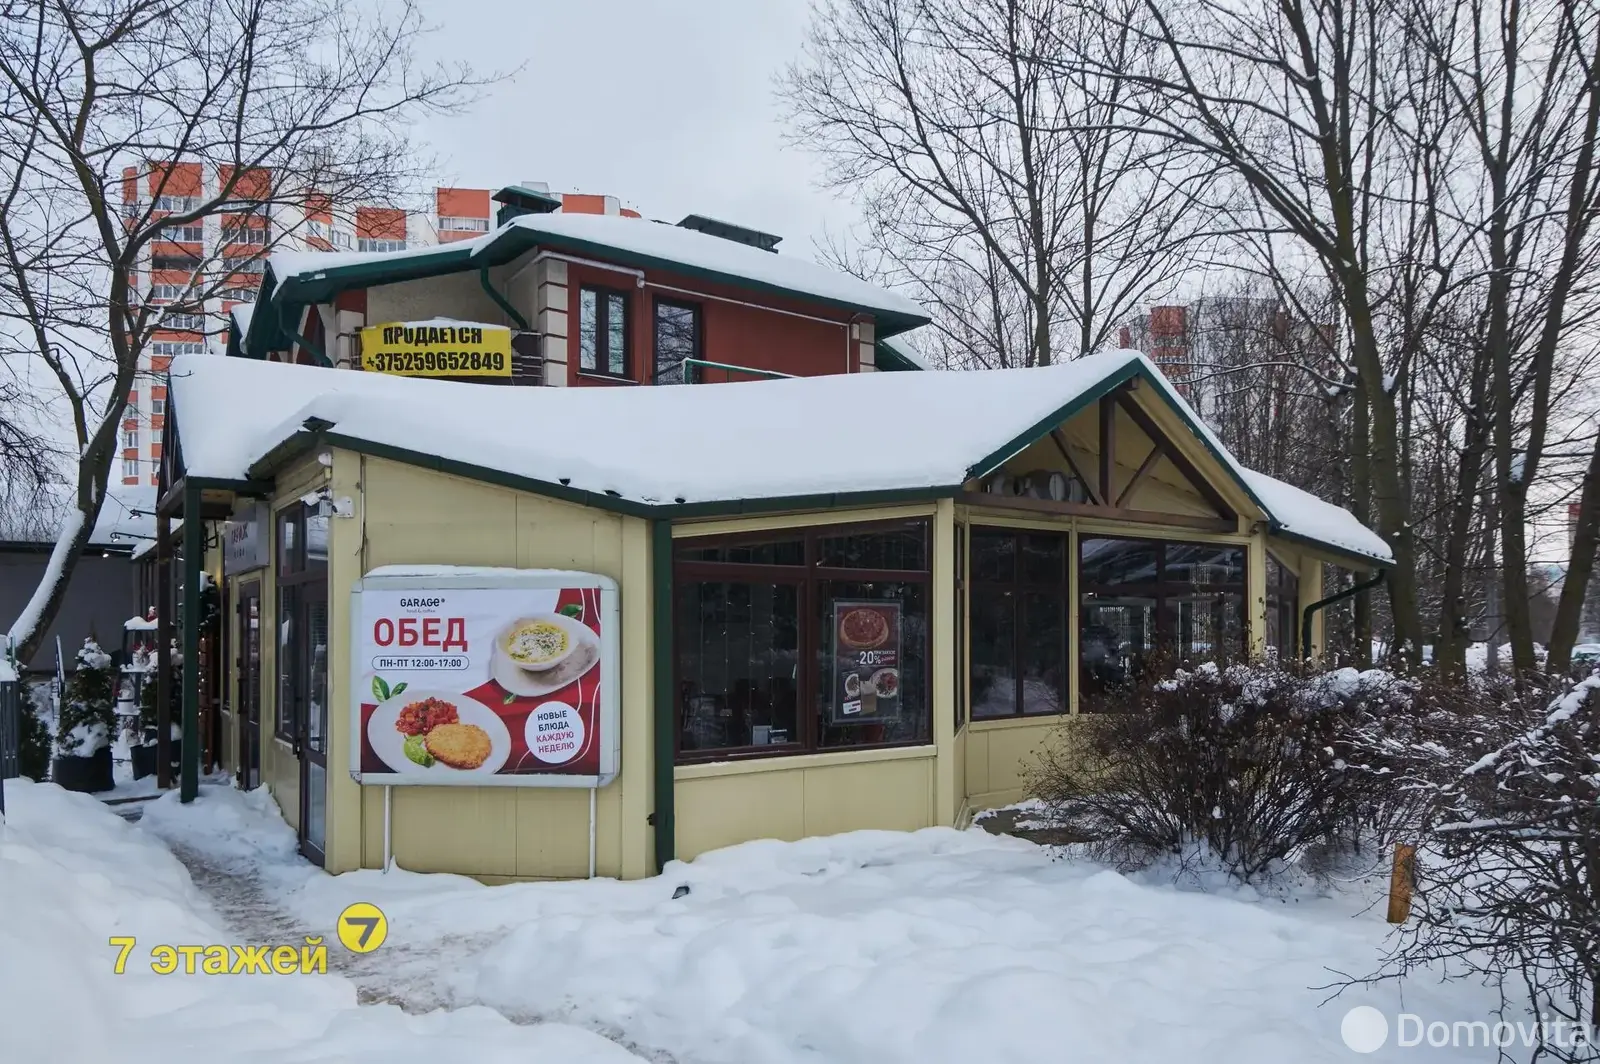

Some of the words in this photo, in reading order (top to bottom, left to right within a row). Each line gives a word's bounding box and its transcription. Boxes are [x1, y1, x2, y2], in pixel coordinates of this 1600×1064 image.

[383, 327, 482, 346] ПРОДАЕТСЯ
[366, 352, 504, 371] +375259652849
[373, 617, 469, 653] ОБЕД
[380, 659, 408, 667] ПН-ПТ
[412, 659, 462, 667] 12:00-17:00
[537, 710, 568, 721] НОВЫЕ
[538, 721, 570, 732] БЛЮДА
[536, 731, 574, 743] КАЖДУЮ
[538, 742, 575, 754] НЕДЕЛЮ
